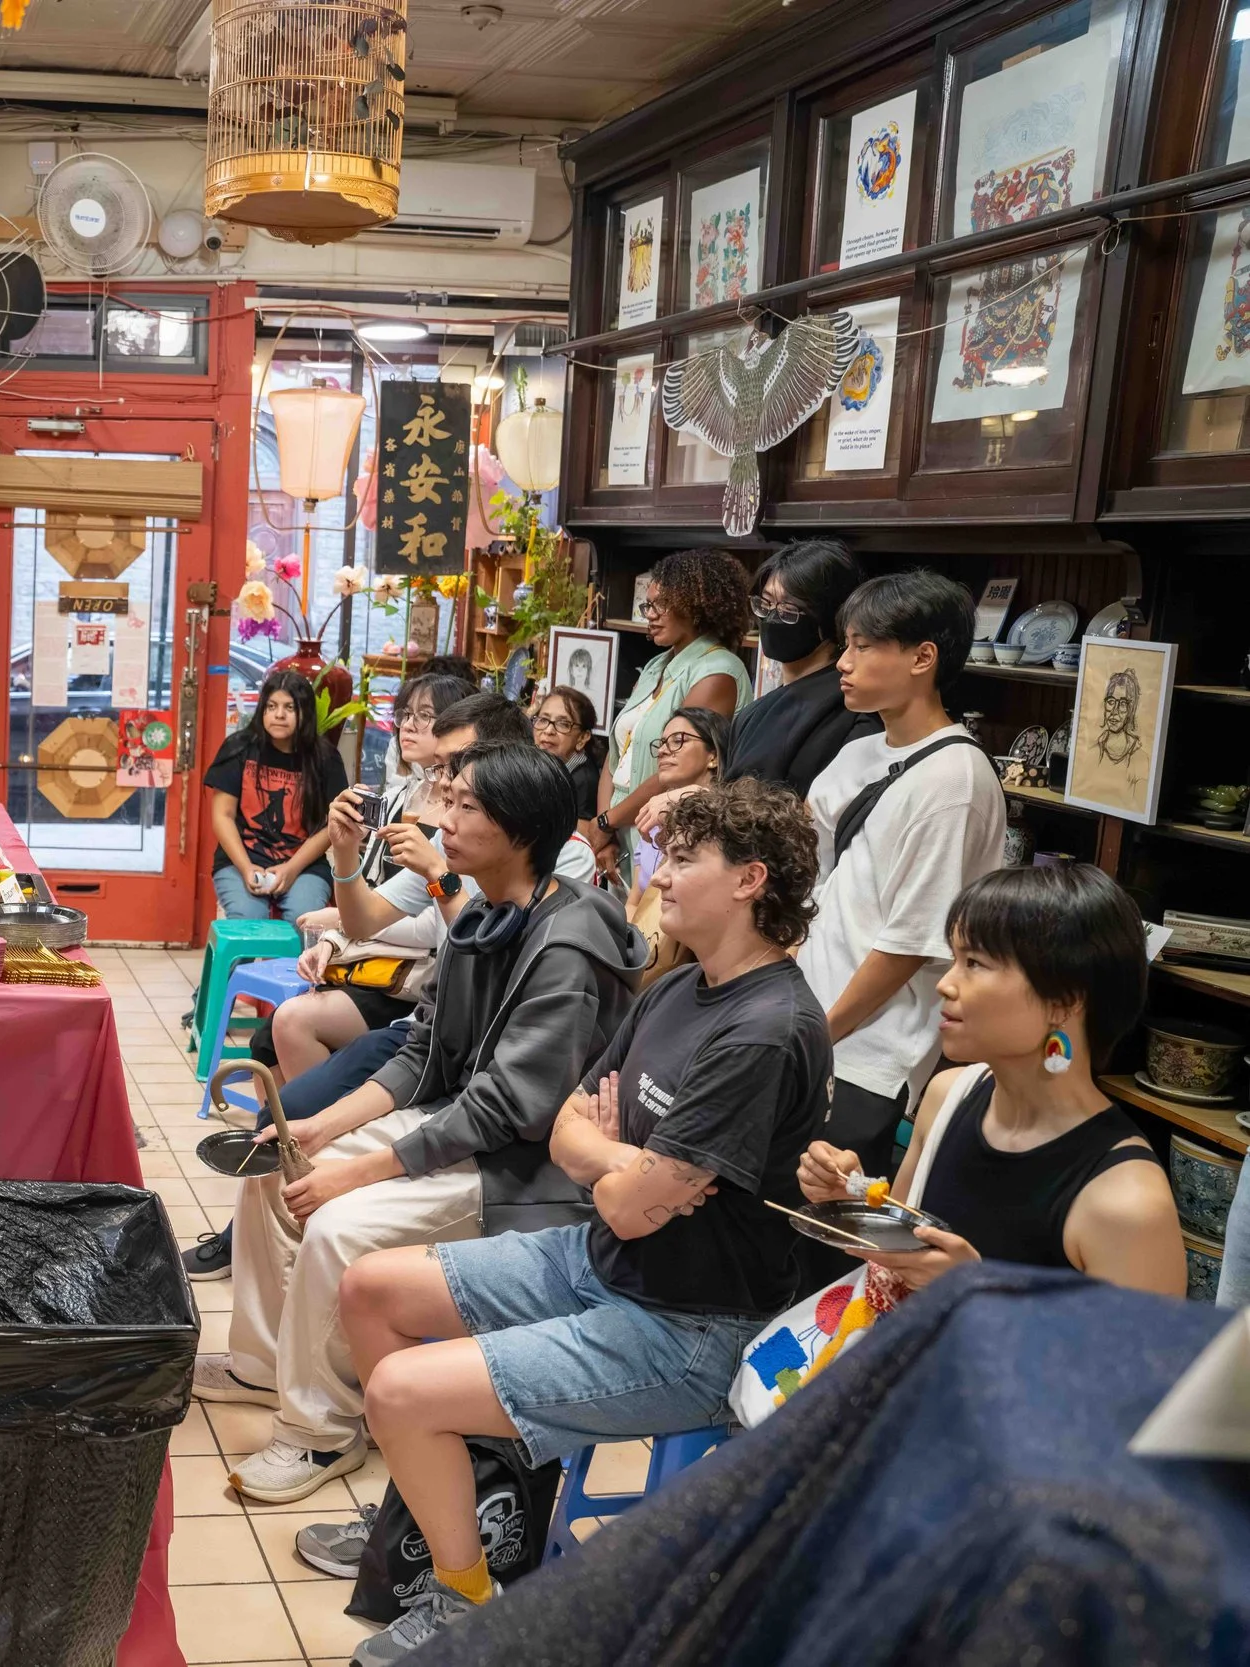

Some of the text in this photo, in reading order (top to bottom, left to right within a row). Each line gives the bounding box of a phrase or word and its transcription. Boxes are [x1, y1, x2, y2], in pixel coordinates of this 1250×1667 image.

[845, 237, 861, 245] Through
[867, 239, 875, 247] find
[875, 235, 898, 245] grounding
[877, 241, 898, 252] curiosity?
[398, 394, 452, 565] 永安和
[73, 599, 114, 612] OPEN
[638, 1089, 648, 1104] the
